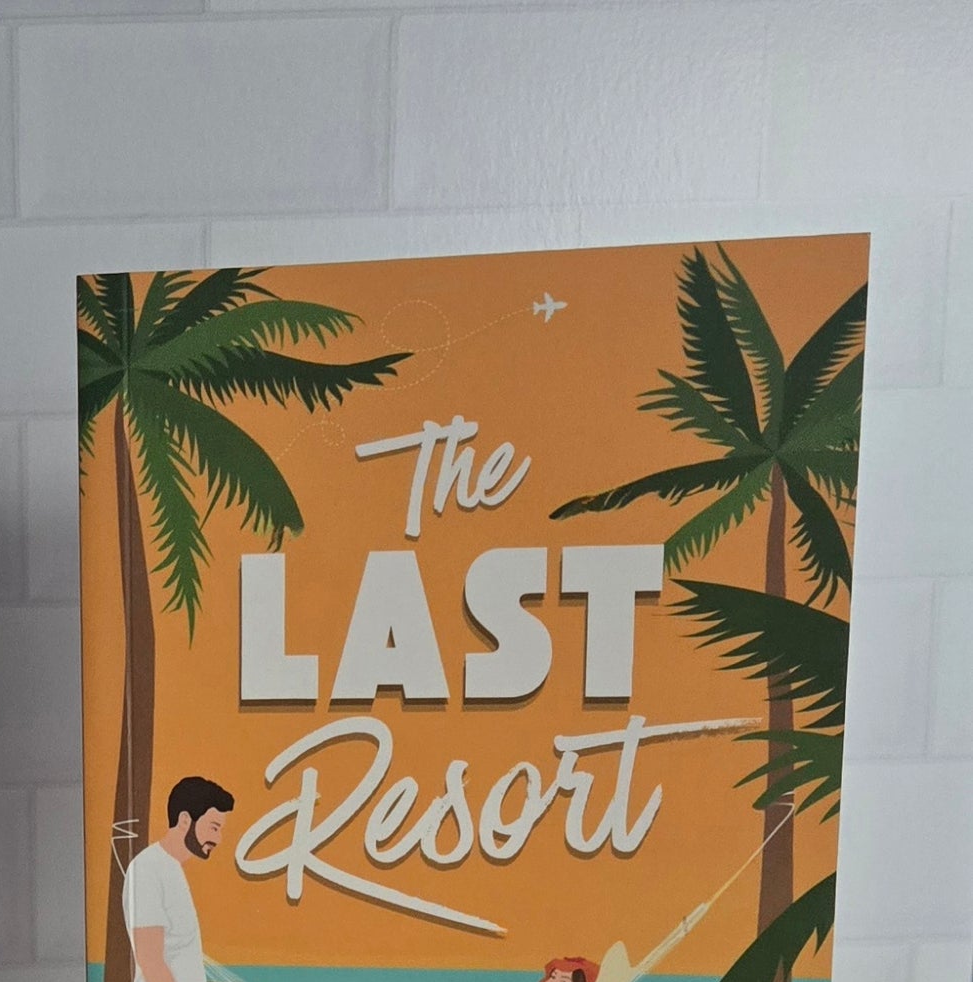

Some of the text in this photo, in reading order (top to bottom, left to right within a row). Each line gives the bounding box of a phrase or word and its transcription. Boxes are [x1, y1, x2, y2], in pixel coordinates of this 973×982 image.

[355, 415, 531, 537] The
[239, 543, 665, 702] LAST
[235, 714, 763, 938] Resort
